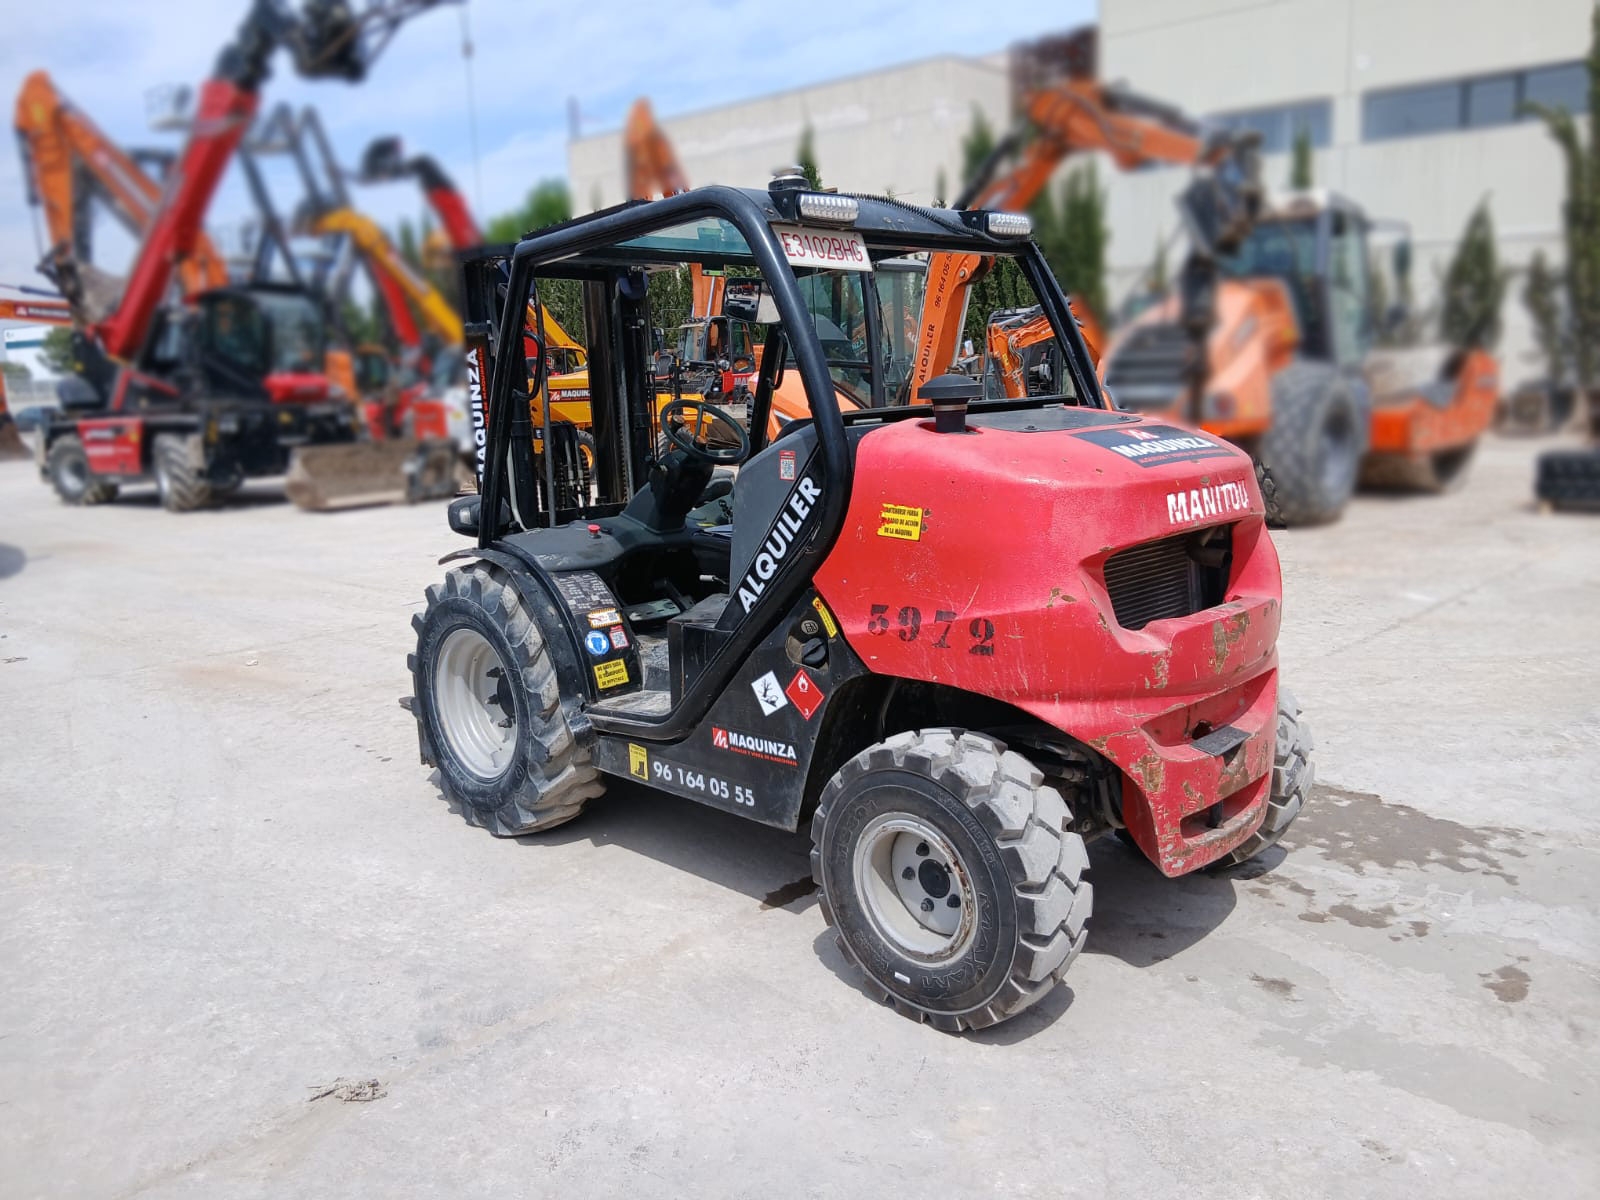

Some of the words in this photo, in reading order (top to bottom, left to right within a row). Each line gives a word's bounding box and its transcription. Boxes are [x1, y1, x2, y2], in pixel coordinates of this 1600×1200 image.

[781, 232, 863, 262] E3102BHG
[561, 389, 590, 398] MAQUIN
[1110, 437, 1219, 457] MAQUINZA
[1166, 479, 1249, 525] MANITOU
[738, 476, 822, 615] ALQUILER
[728, 731, 797, 760] MAQUINZA
[653, 761, 673, 781] 96
[677, 767, 706, 791] 164
[709, 777, 730, 799] 05
[735, 785, 755, 807] 55
